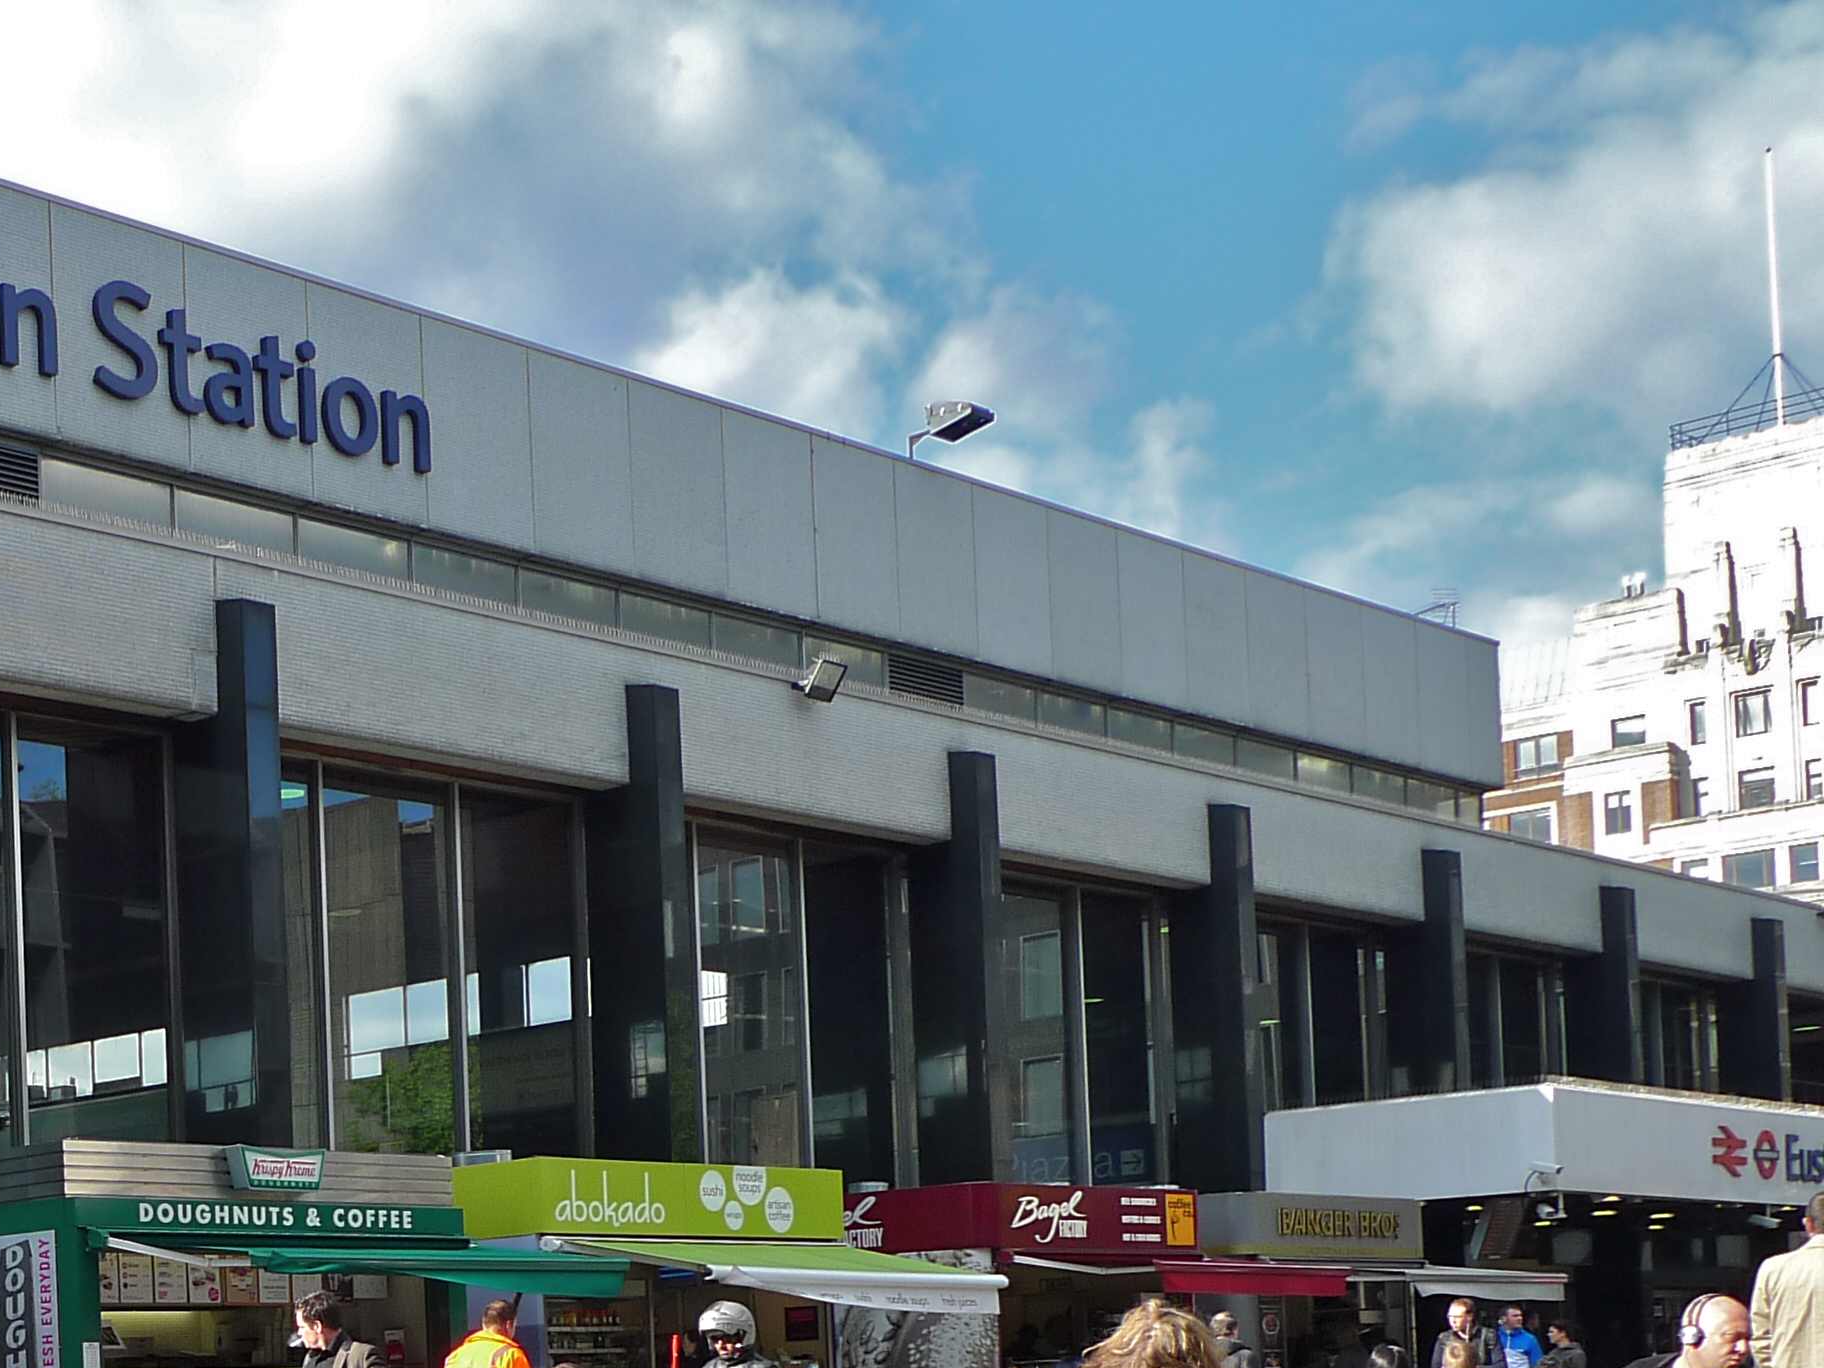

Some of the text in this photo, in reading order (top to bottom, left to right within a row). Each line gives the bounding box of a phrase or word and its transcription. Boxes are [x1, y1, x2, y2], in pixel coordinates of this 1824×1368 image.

[92, 279, 432, 474] Station
[252, 1158, 317, 1179] Krispy Kreme
[736, 1171, 763, 1183] noodle
[1012, 1150, 1115, 1184] iaza
[555, 1169, 666, 1228] abokado
[702, 1184, 724, 1197] sushi
[738, 1183, 761, 1196] soups
[139, 1203, 413, 1229] DOUGHNUTS & COFFEE
[767, 1199, 792, 1210] artisan
[768, 1211, 791, 1221] coffee
[1010, 1190, 1088, 1243] Bagel
[1278, 1207, 1353, 1237] BANGER
[38, 1238, 53, 1327] EVERYDAY
